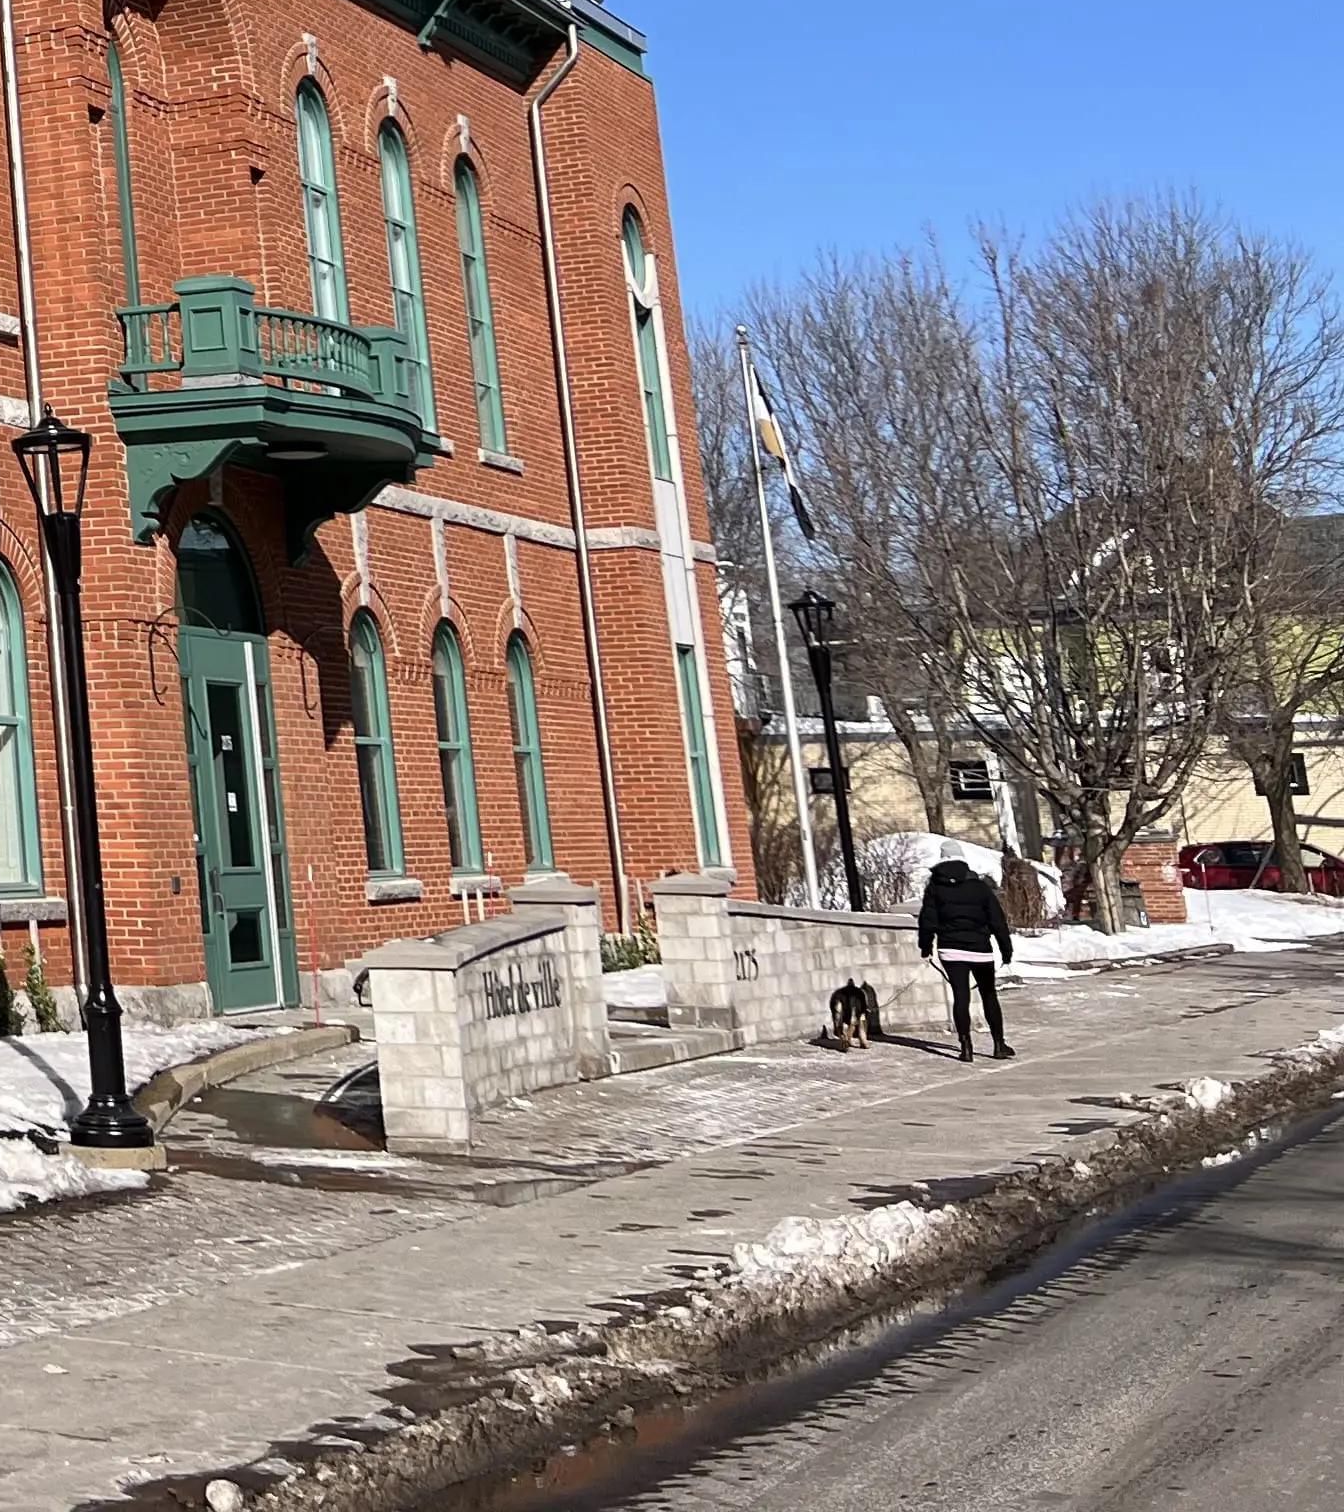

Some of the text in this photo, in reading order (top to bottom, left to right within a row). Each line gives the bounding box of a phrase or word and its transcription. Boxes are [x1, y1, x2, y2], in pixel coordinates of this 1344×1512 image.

[482, 960, 561, 1020] Hôtel de ville
